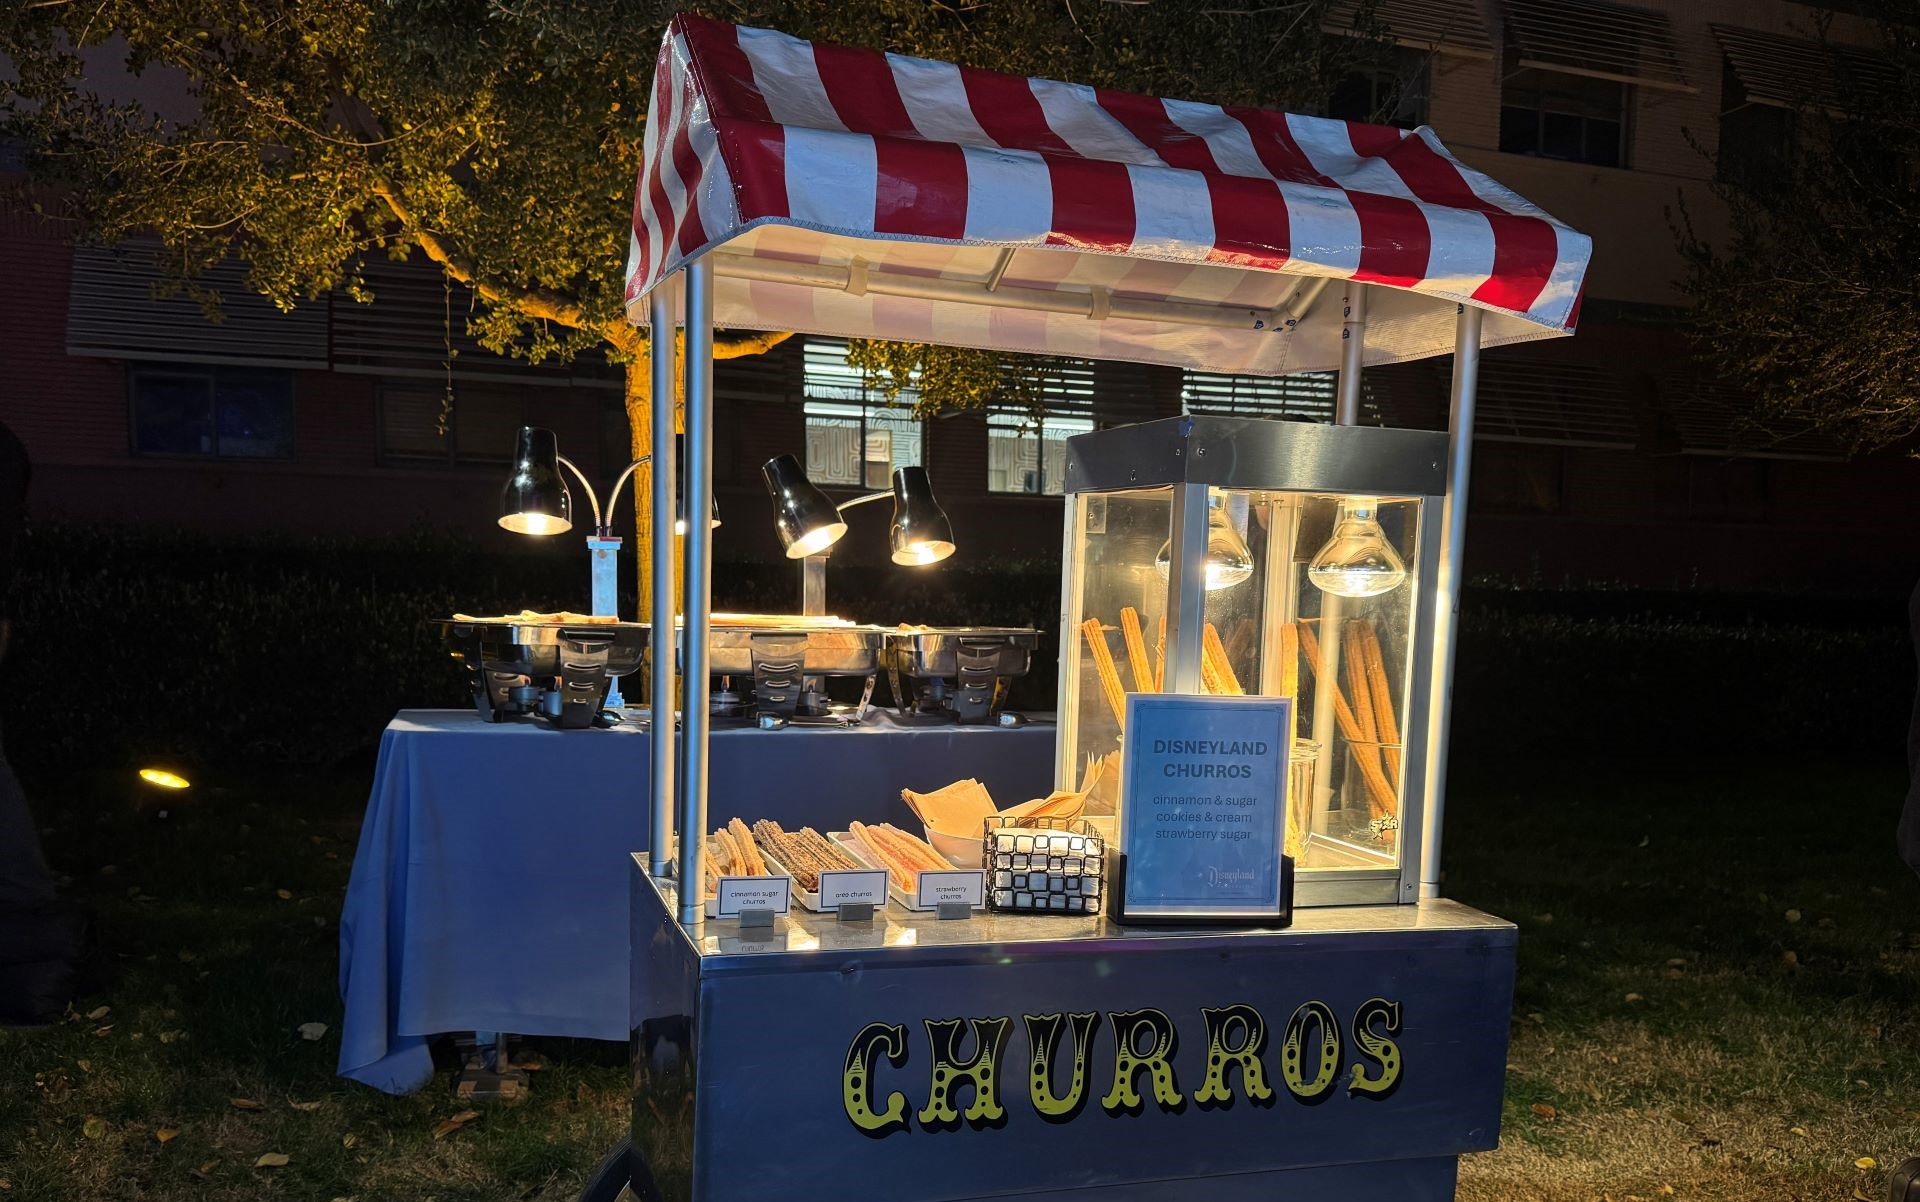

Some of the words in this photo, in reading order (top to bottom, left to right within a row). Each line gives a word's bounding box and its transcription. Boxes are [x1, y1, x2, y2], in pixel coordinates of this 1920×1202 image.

[1153, 740, 1268, 755] DISNEYLAND
[1163, 763, 1252, 778] CHURROS
[1153, 794, 1212, 805] cinnamon
[1214, 795, 1223, 806] &
[1225, 797, 1257, 808] sugar
[1156, 811, 1202, 822] cookies
[1204, 812, 1213, 822] &
[1215, 814, 1252, 823] cream
[1155, 828, 1218, 840] strawberry
[1220, 830, 1252, 841] sugar
[1207, 865, 1255, 888] Disneyland
[761, 890, 779, 898] sugar
[842, 997, 1404, 1139] CHURROS
